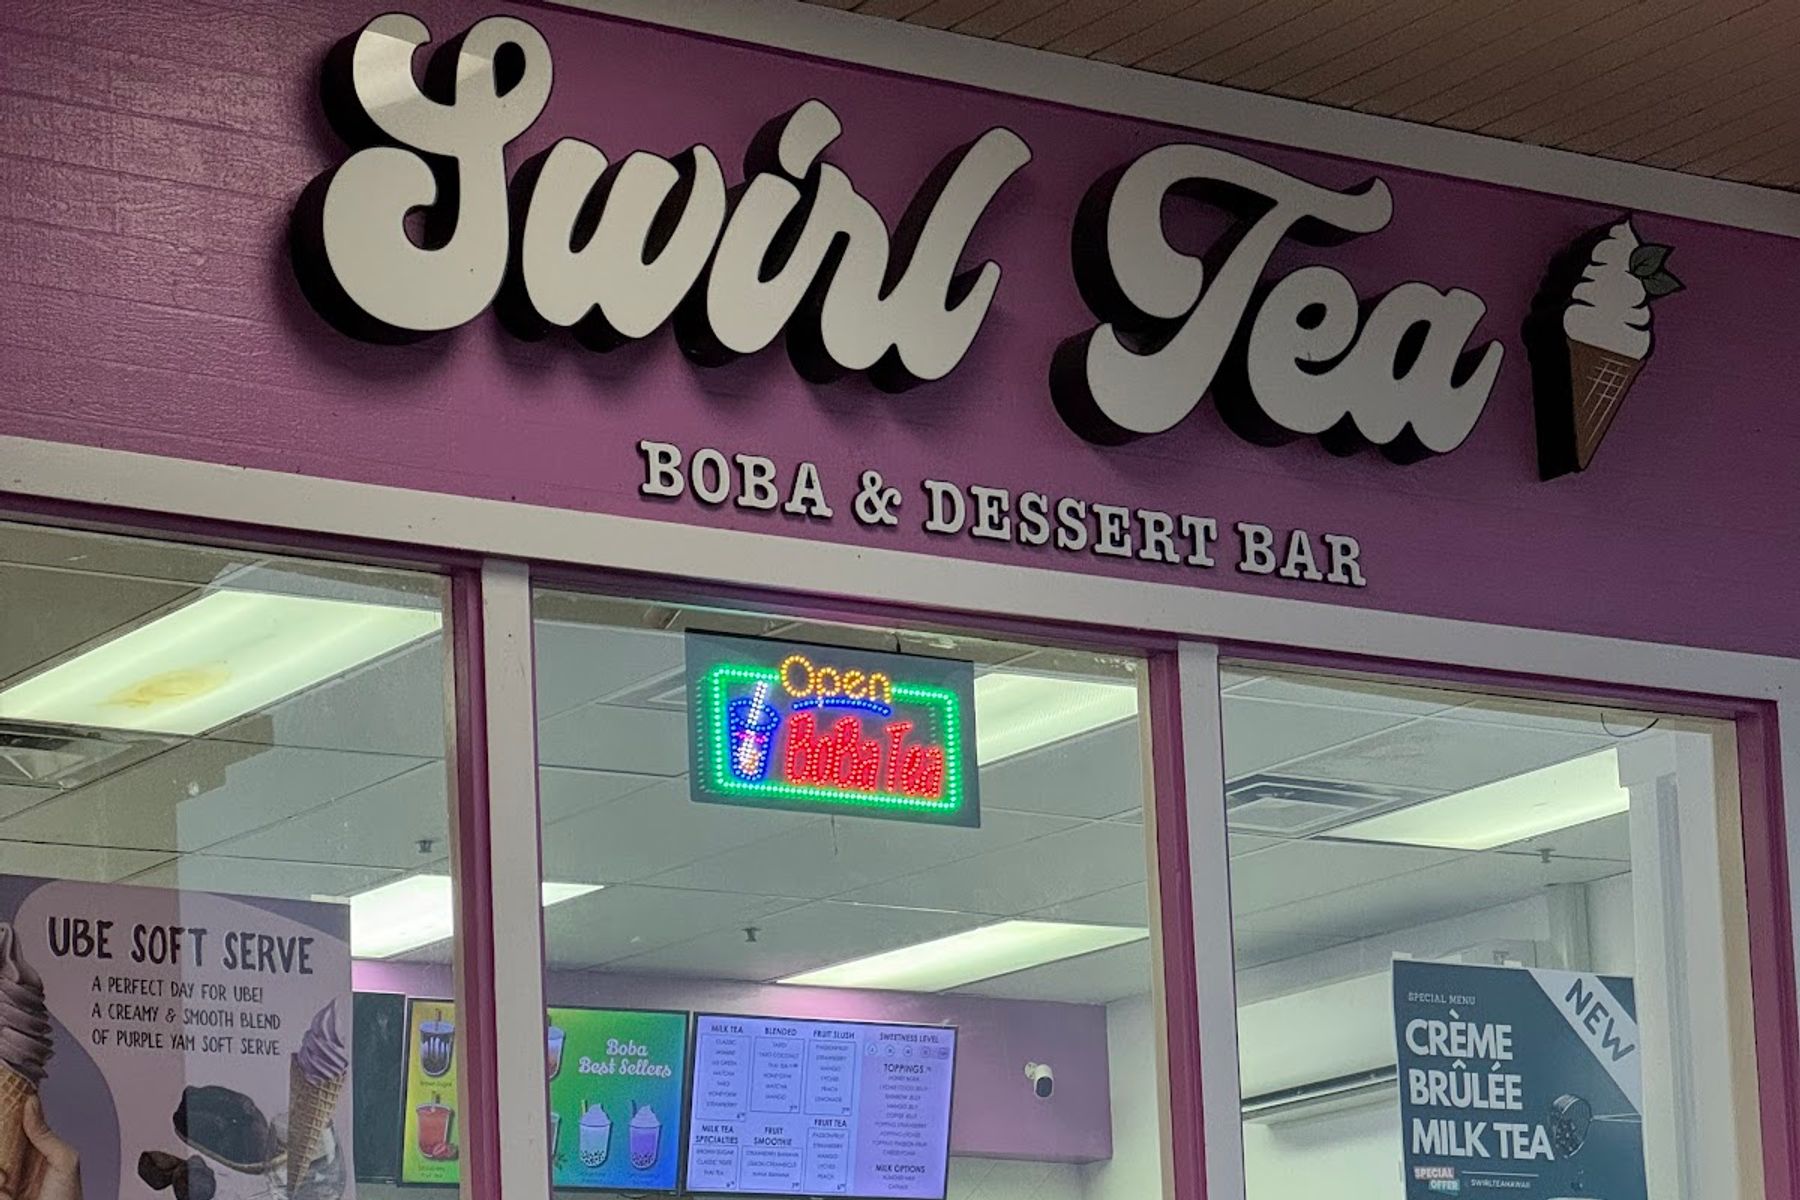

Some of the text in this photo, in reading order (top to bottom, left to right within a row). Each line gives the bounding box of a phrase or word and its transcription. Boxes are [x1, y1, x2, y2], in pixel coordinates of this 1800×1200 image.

[322, 14, 1505, 456] Swirl Tea
[639, 440, 1367, 587] BOBA & DESSERT BAR
[779, 654, 893, 709] Open
[784, 711, 946, 800] Boba Tea
[48, 917, 315, 976] UBE SOFT SERVE
[92, 976, 264, 1003] A PERFECT DAY FOR UBE!
[1408, 992, 1476, 1006] SPECIAL MENU
[92, 1003, 282, 1030] A CREAMY & SMOOTH BLEND
[1564, 978, 1636, 1063] NEW
[92, 1029, 281, 1056] OF PURPLE YAM SOFT SERVE
[606, 1038, 649, 1057] Boba
[1405, 1009, 1513, 1061] CRÈME
[578, 1056, 672, 1078] Best Sellers
[883, 1063, 924, 1074] TOPPINGS
[1408, 1059, 1524, 1111] BRÛLÉE
[1412, 1118, 1555, 1161] MILK TEA
[1413, 1166, 1455, 1179] SPECIAL
[1429, 1179, 1460, 1191] OFFER
